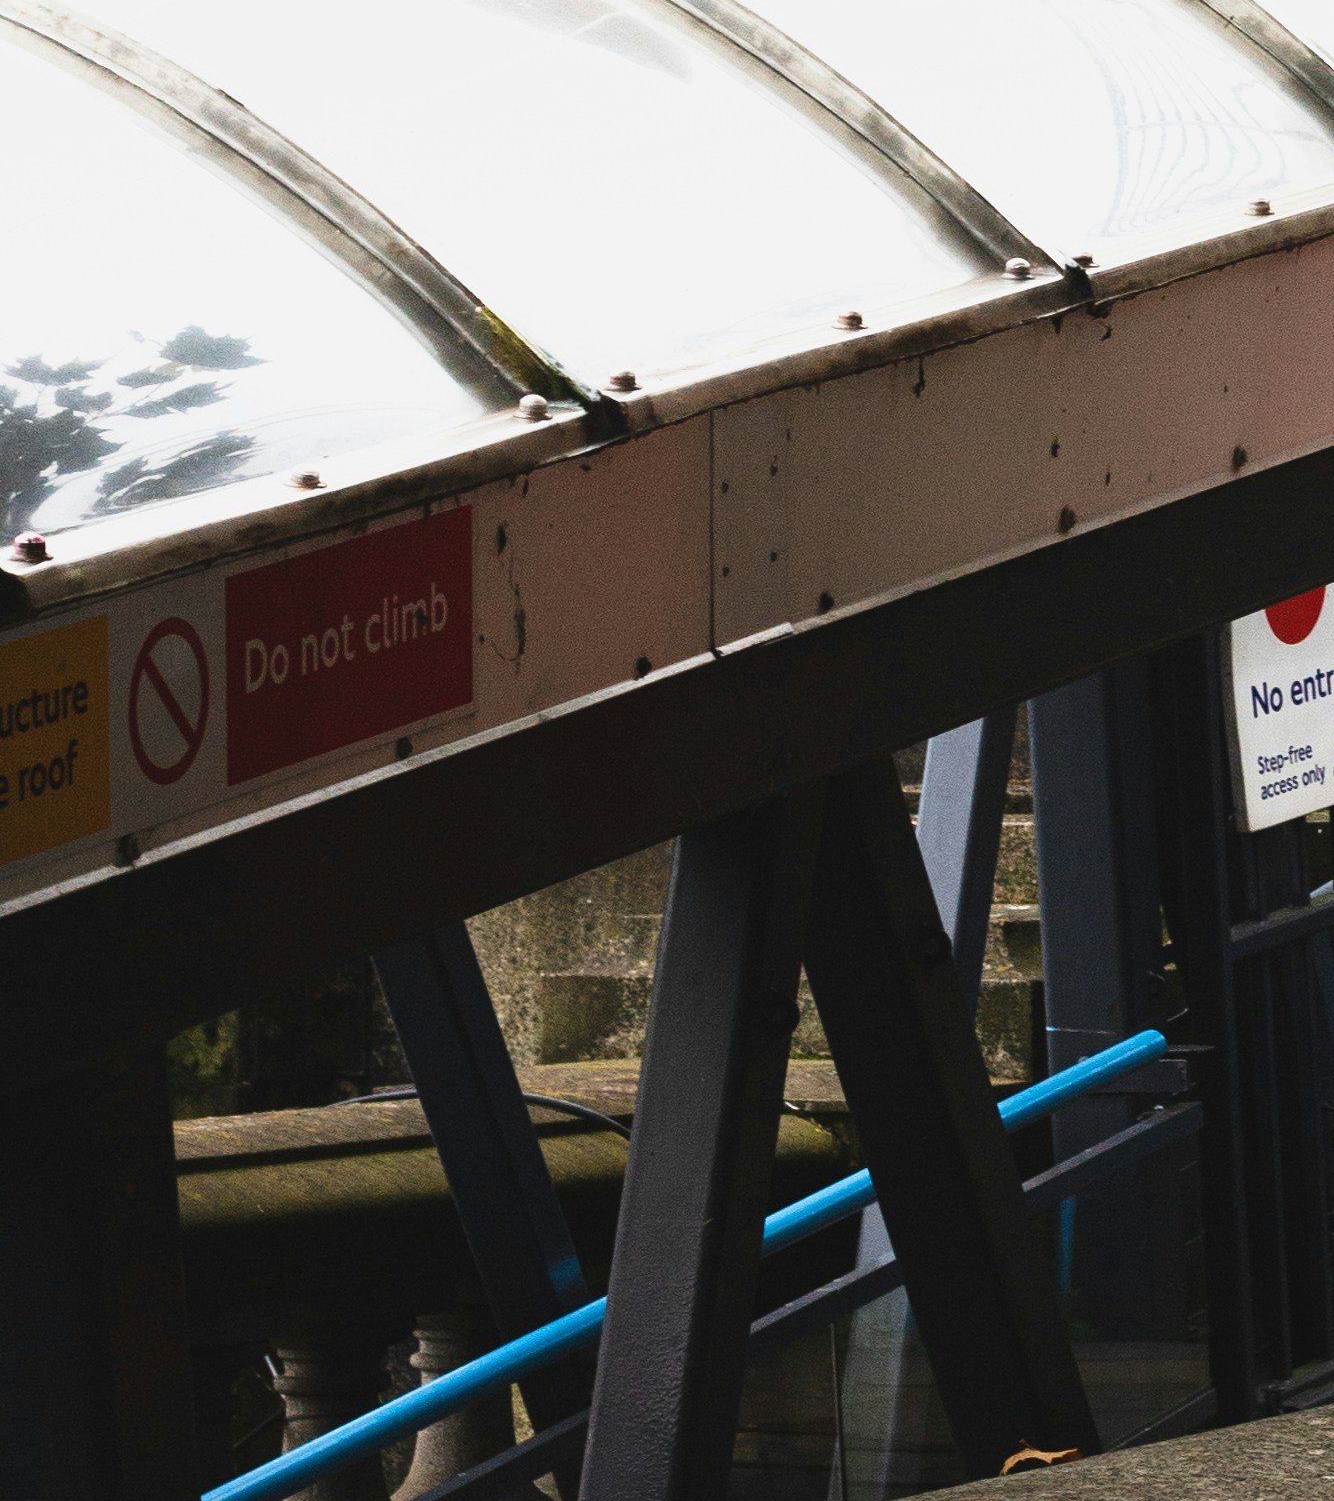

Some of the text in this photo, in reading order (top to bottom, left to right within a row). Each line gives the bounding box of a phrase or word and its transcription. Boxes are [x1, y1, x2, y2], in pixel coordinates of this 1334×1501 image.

[245, 582, 449, 694] Do not climb
[0, 681, 88, 738] ucture
[1251, 681, 1283, 718] No
[18, 738, 79, 802] roof
[1257, 745, 1313, 774] Step-free
[1261, 764, 1325, 800] access only
